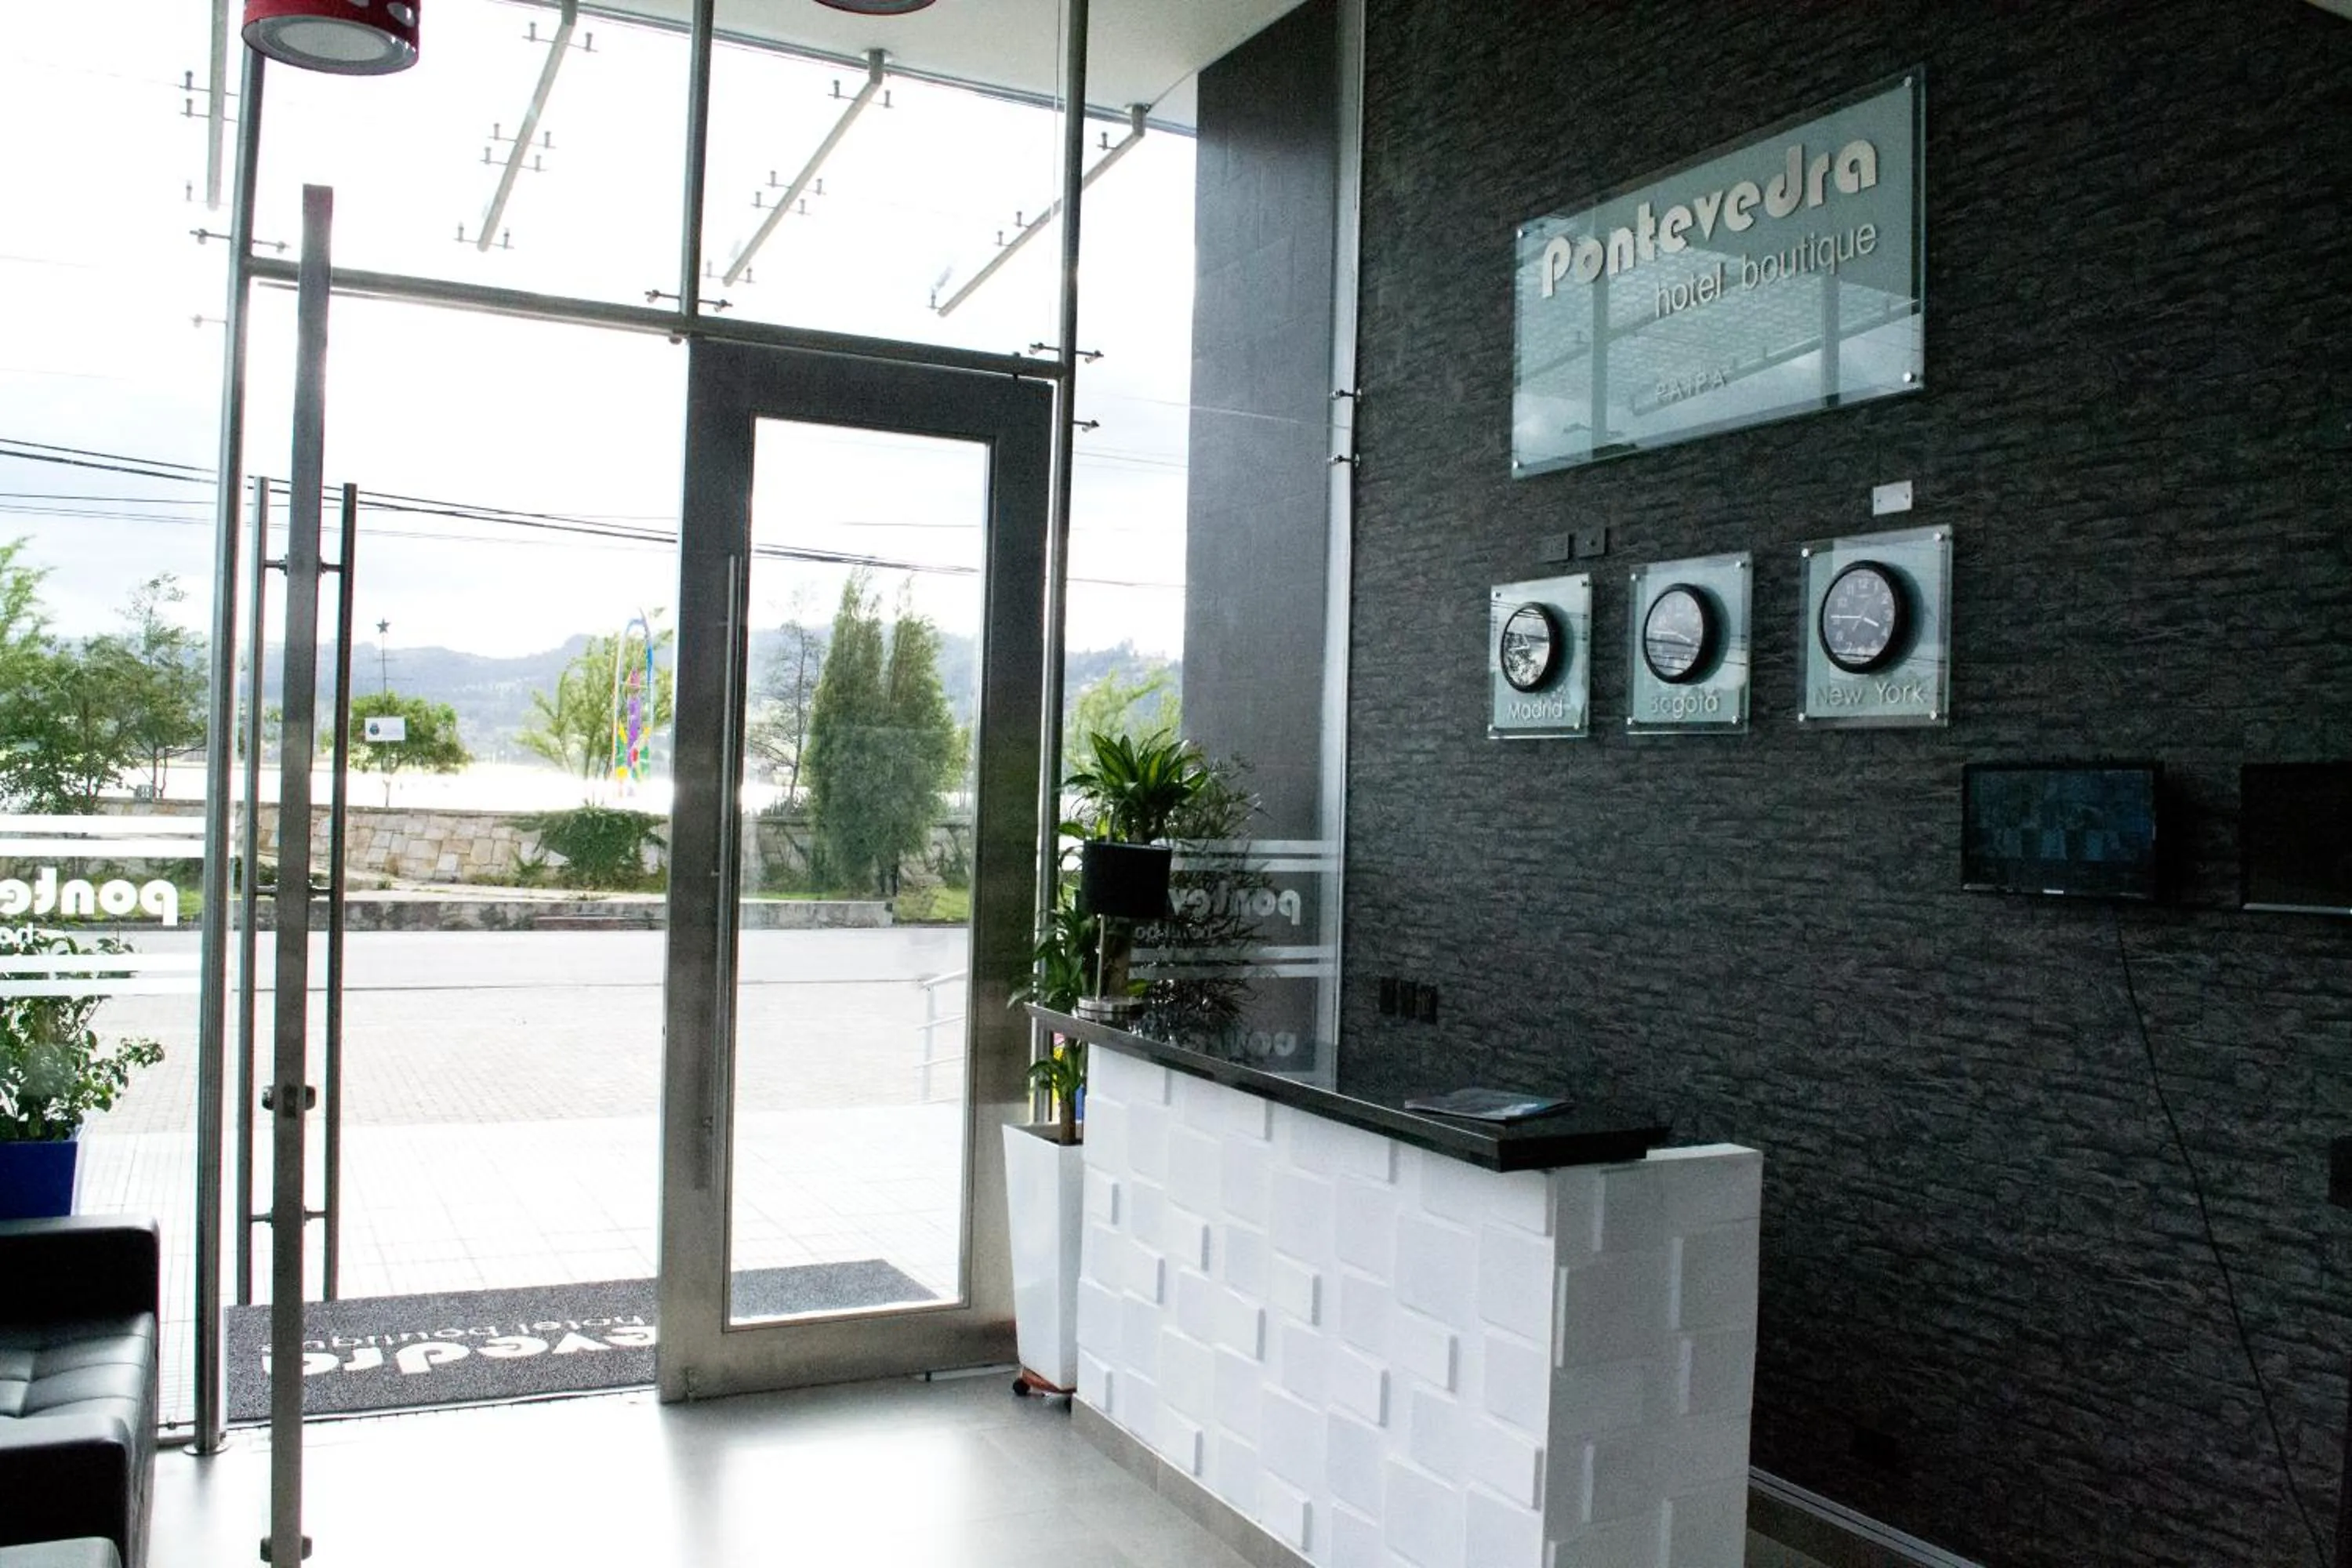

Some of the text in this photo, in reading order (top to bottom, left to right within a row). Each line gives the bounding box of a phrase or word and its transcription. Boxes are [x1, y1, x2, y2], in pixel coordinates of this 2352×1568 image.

[1542, 140, 1877, 298] pontevedra
[1656, 223, 1877, 318] hotel boutique
[1508, 699, 1563, 719] Madrid
[1815, 681, 1926, 706] New York
[262, 1315, 646, 1354] hotel boutiqu
